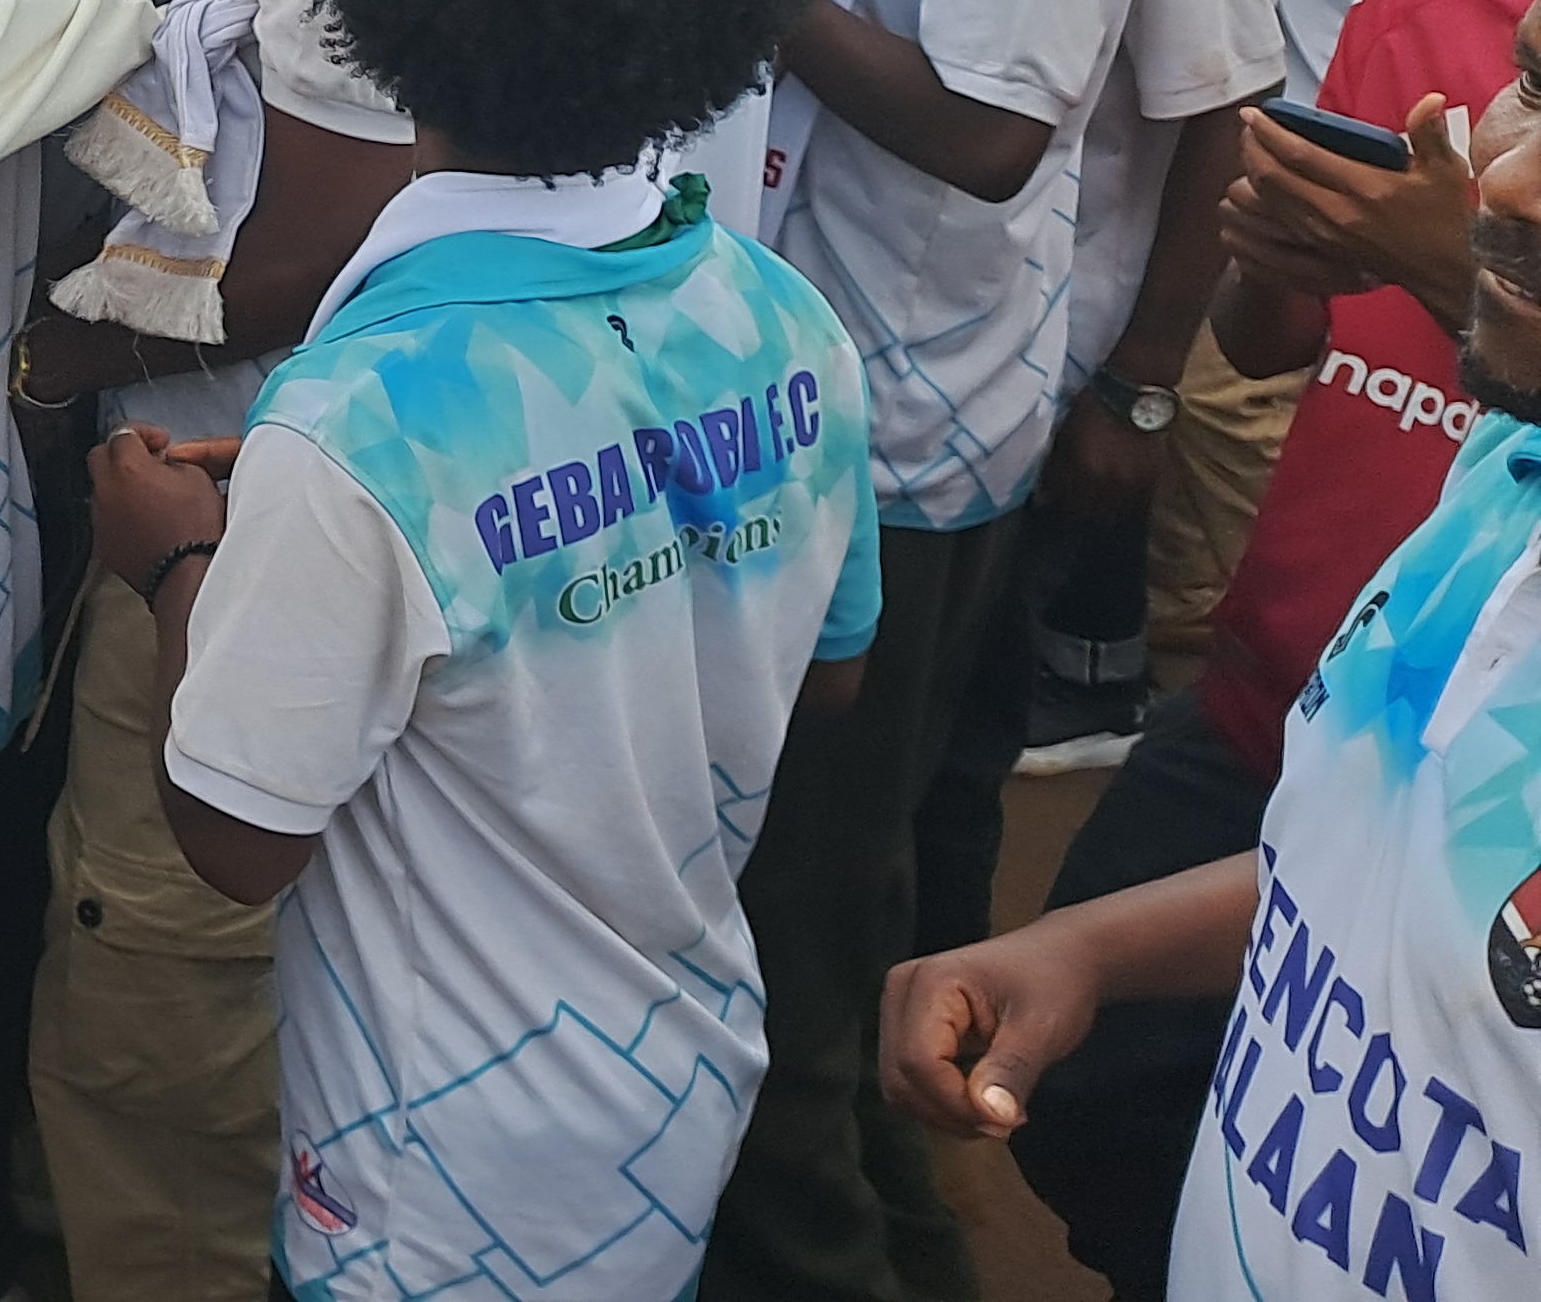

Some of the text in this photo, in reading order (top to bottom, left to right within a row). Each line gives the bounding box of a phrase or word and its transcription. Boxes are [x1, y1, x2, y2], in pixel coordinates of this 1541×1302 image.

[474, 369, 820, 576] GEBA ROBI F.C
[1250, 841, 1528, 1258] ENCOTA
